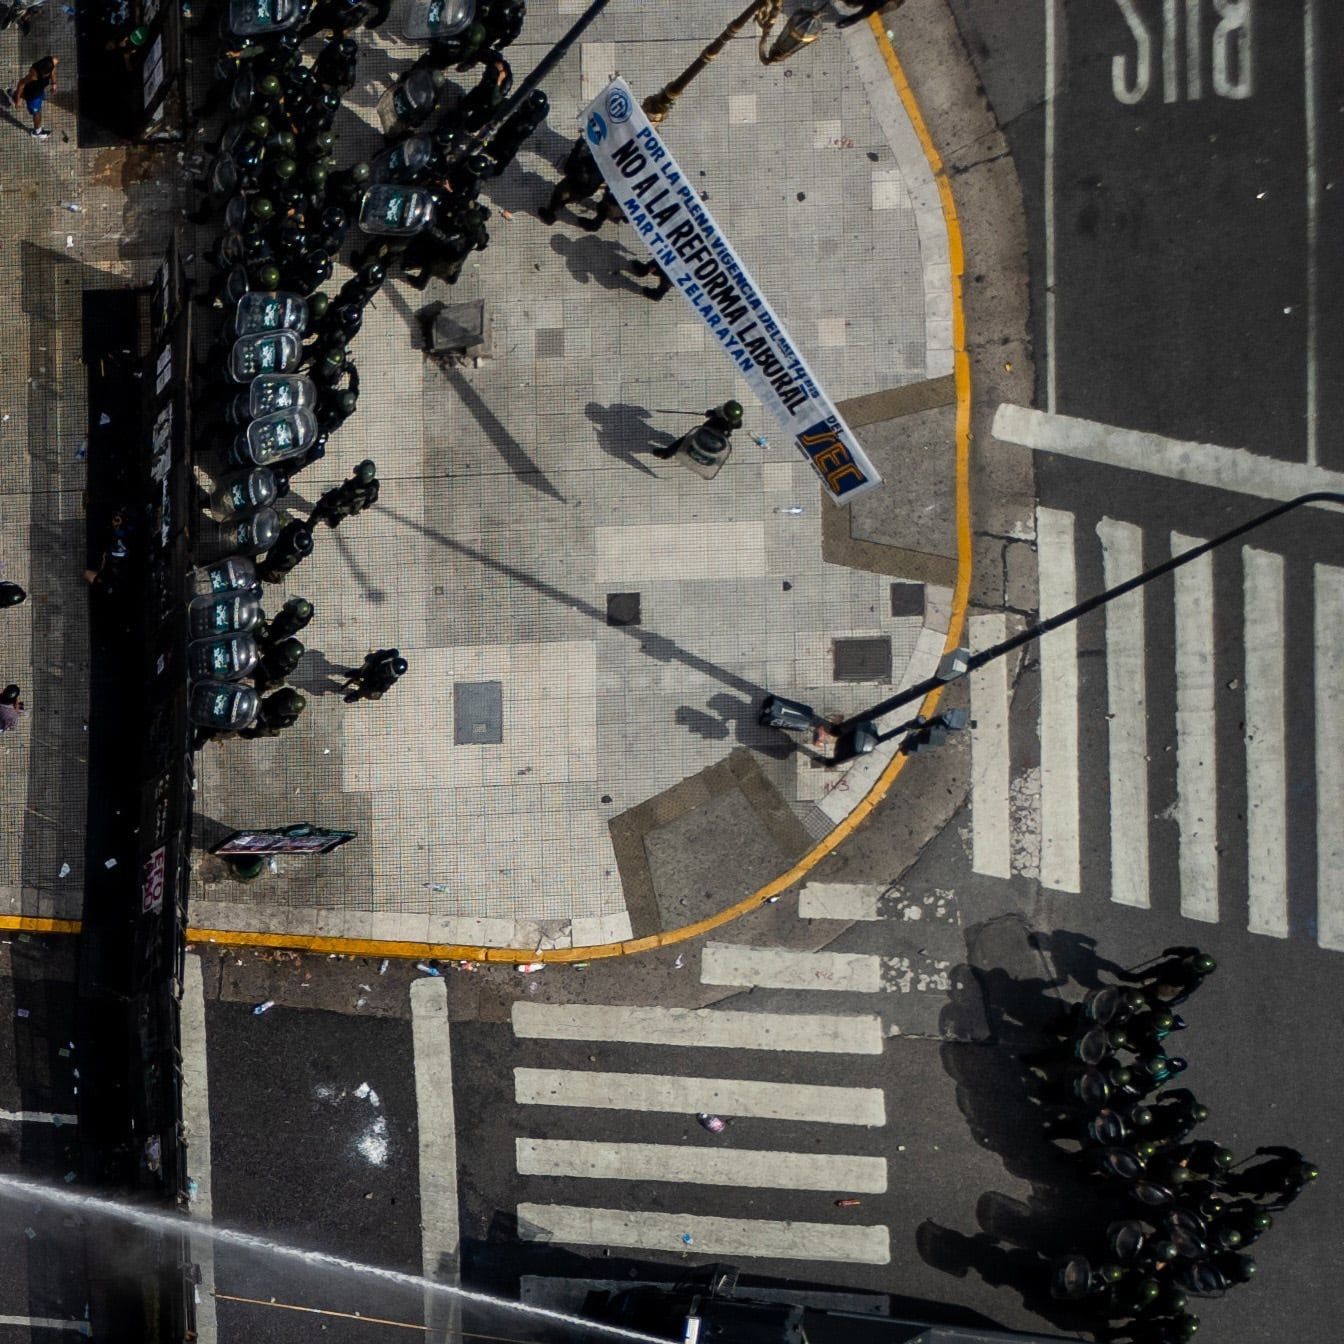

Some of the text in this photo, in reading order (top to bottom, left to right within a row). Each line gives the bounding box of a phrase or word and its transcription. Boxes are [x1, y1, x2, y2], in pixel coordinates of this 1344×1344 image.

[611, 138, 811, 416] NO A LA REFORMA LABORAL
[637, 127, 664, 162] POR
[661, 161, 680, 187] LA
[678, 186, 714, 240] PLENA
[758, 309, 781, 342] DEL
[789, 357, 811, 382] 14
[676, 272, 753, 373] ZELARAYAN
[800, 426, 868, 495] SEC
